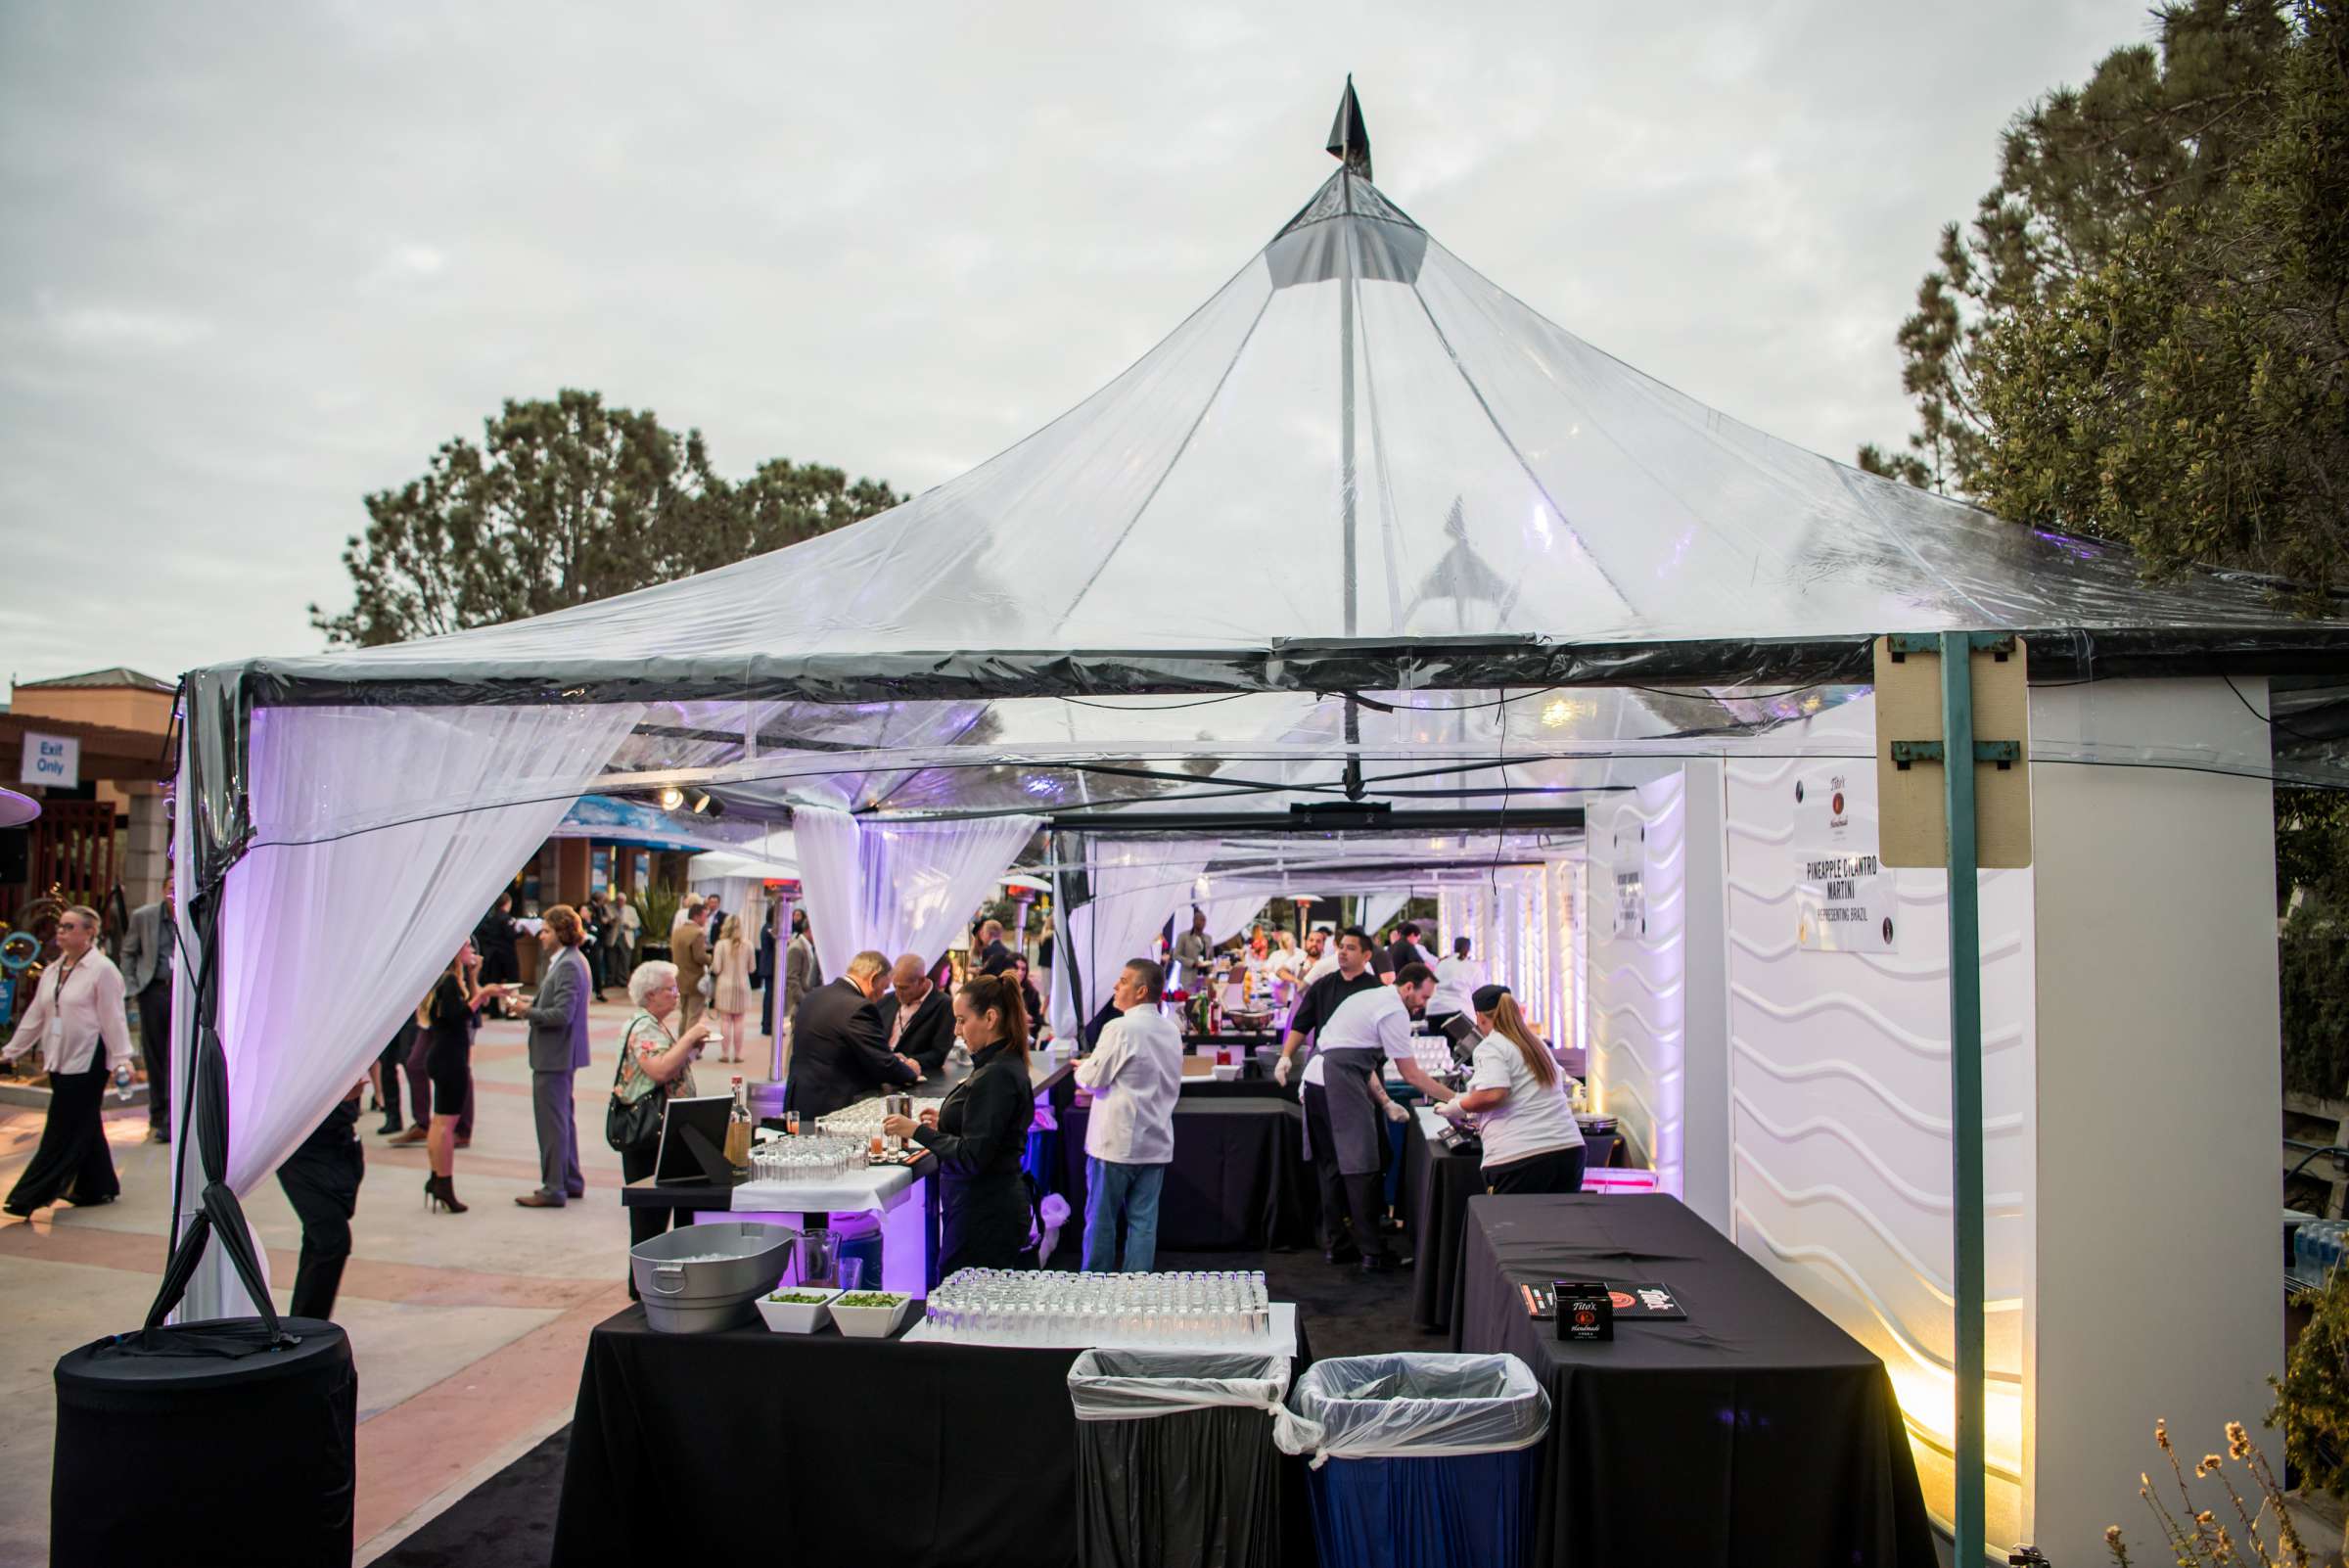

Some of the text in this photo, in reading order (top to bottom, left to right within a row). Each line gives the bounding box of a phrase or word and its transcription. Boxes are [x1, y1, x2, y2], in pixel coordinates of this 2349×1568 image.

[40, 741, 63, 757] Exit
[37, 757, 65, 776] Only
[1807, 858, 1841, 881] PINEAPPLE
[1827, 879, 1855, 900] MARTINI
[1818, 906, 1868, 922] REPRESENTING BRAZIL
[1573, 1302, 1597, 1311] Tito's
